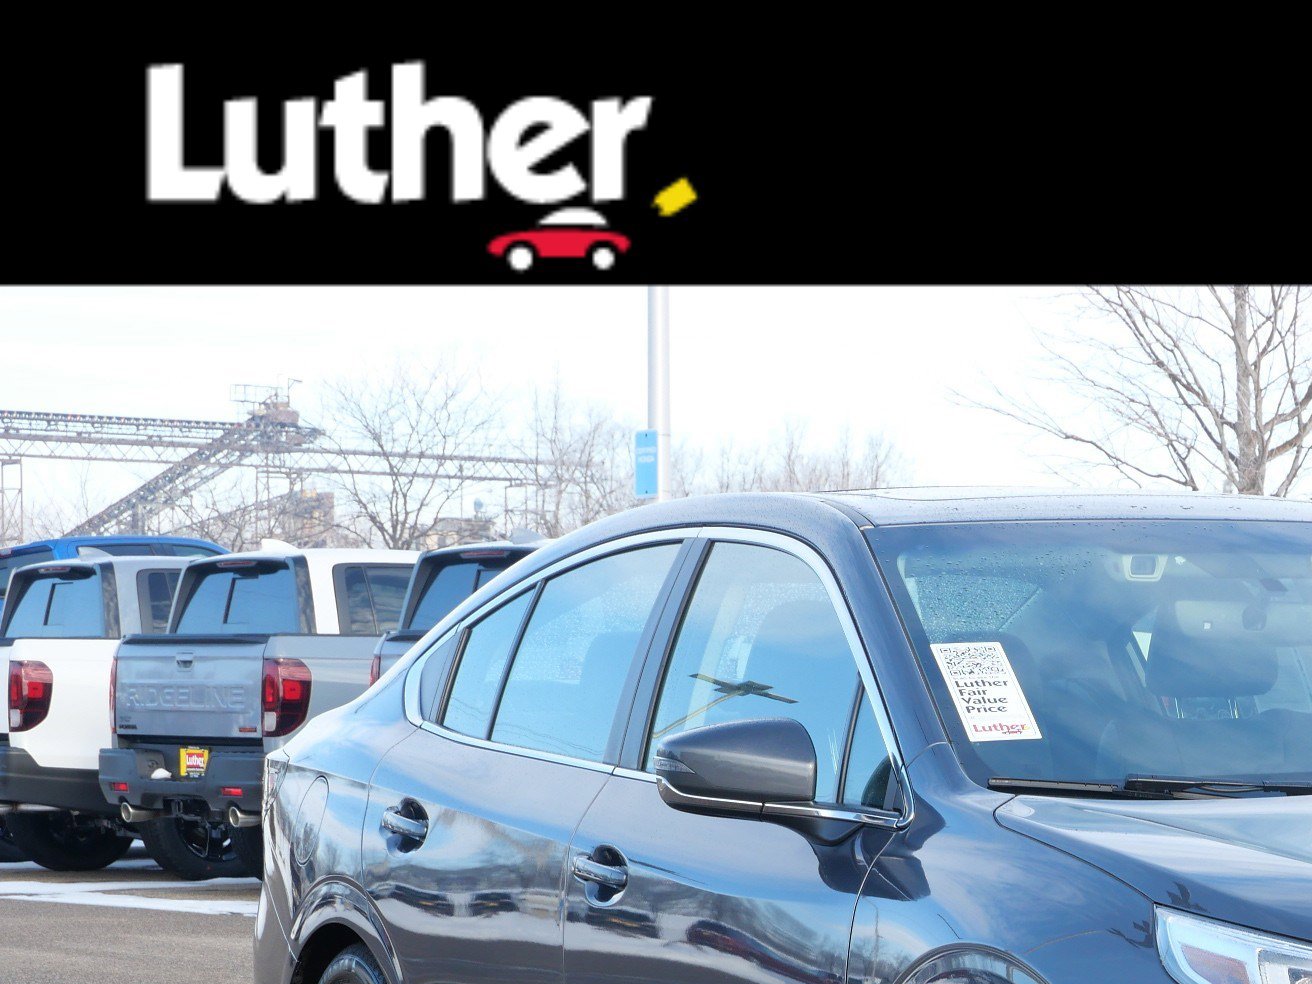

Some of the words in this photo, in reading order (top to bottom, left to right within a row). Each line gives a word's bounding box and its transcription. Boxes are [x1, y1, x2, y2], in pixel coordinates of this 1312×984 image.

[954, 680, 1008, 688] Luther
[958, 688, 988, 697] Fair
[126, 687, 246, 709] RIDGELINE
[961, 696, 1008, 704] Value
[965, 704, 1008, 713] Price
[973, 723, 1027, 733] Luther
[186, 754, 204, 767] Luther
